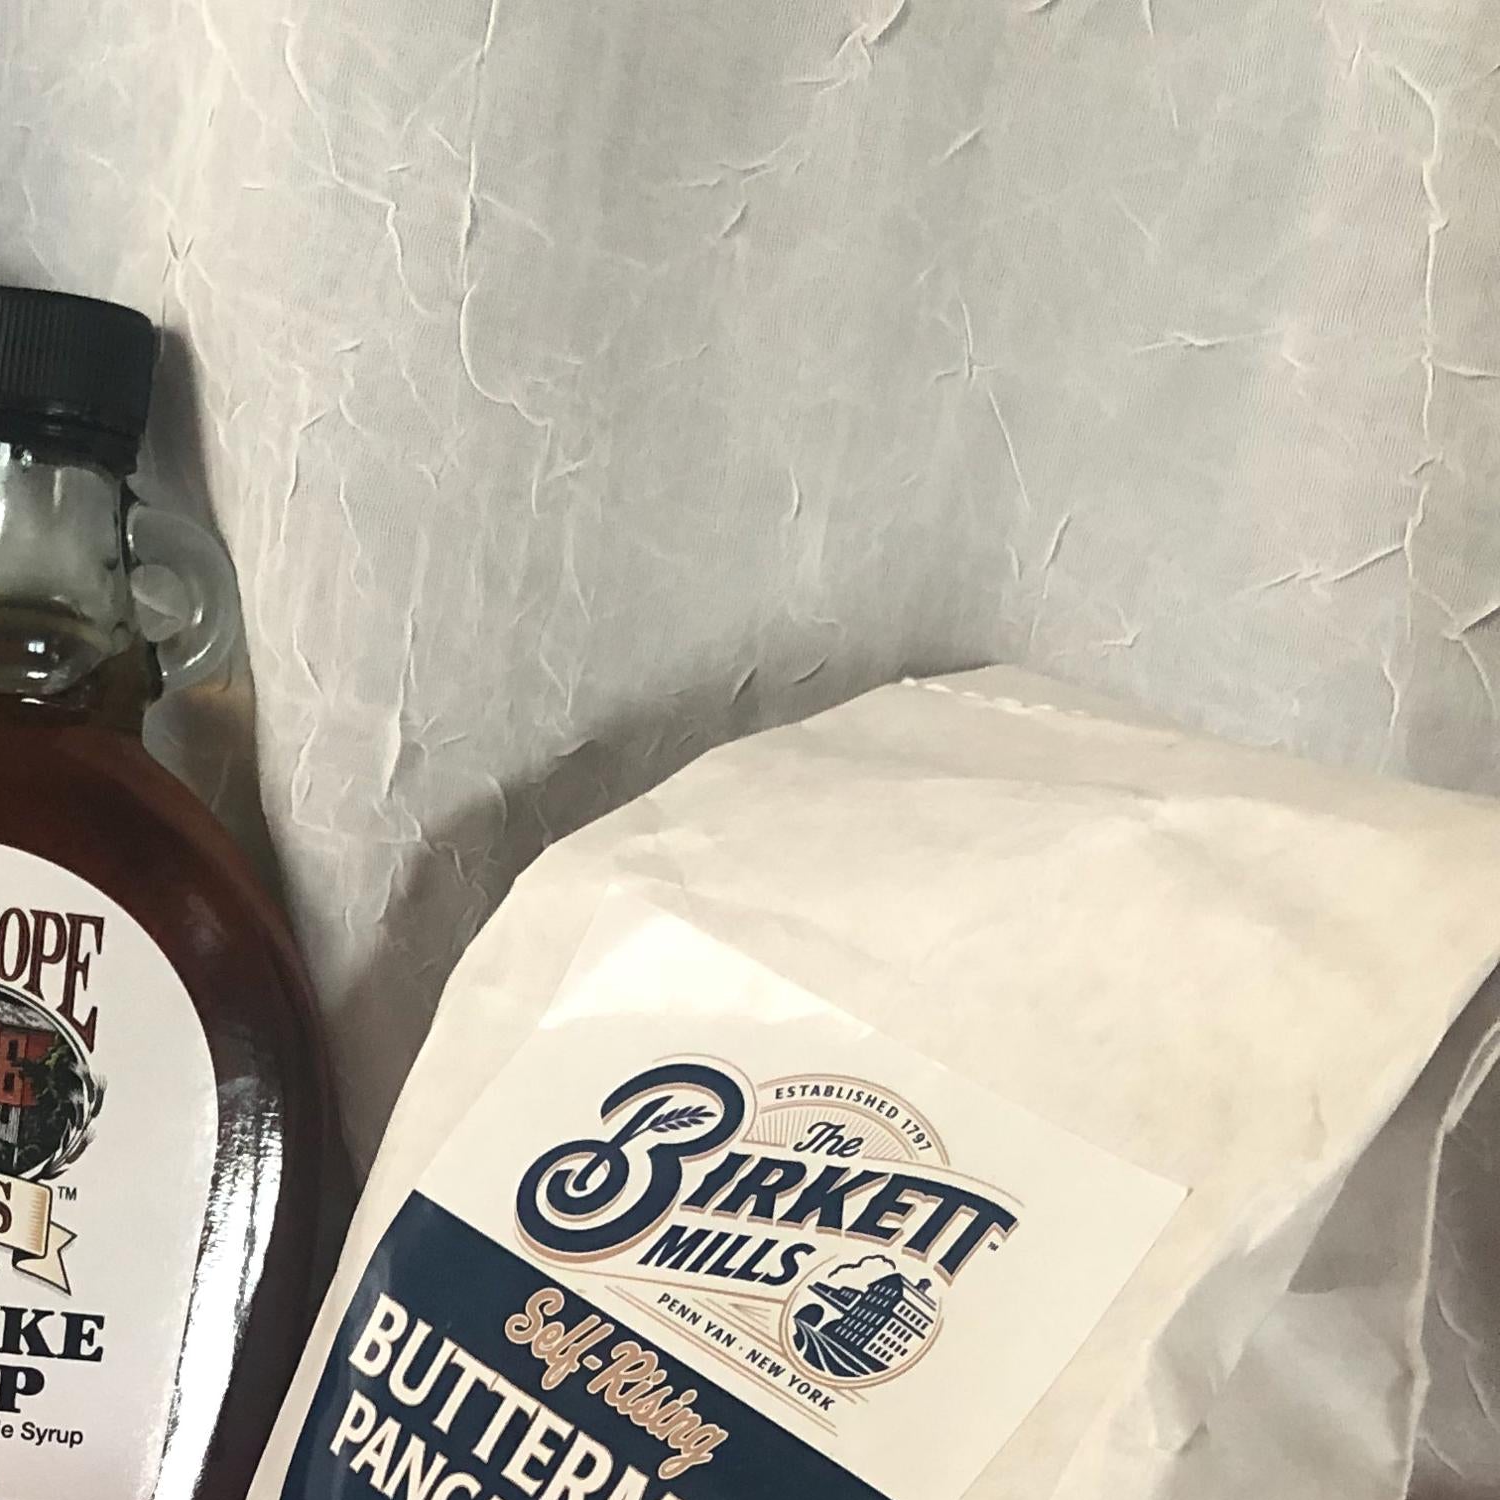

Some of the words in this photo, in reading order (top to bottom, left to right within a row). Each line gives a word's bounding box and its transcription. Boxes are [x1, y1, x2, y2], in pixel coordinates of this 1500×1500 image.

[775, 1085, 898, 1119] ESTABLISHED
[900, 1119, 932, 1151] 1797
[793, 1121, 864, 1157] The
[515, 1063, 1018, 1286] BIRKETT
[637, 1225, 816, 1286] MILLS
[505, 1288, 728, 1479] Self-Rising
[657, 1293, 702, 1326] PENN
[703, 1321, 737, 1347] YAN
[745, 1349, 786, 1378] NEW
[787, 1375, 836, 1411] YORK
[20, 1421, 84, 1448] Syrup
